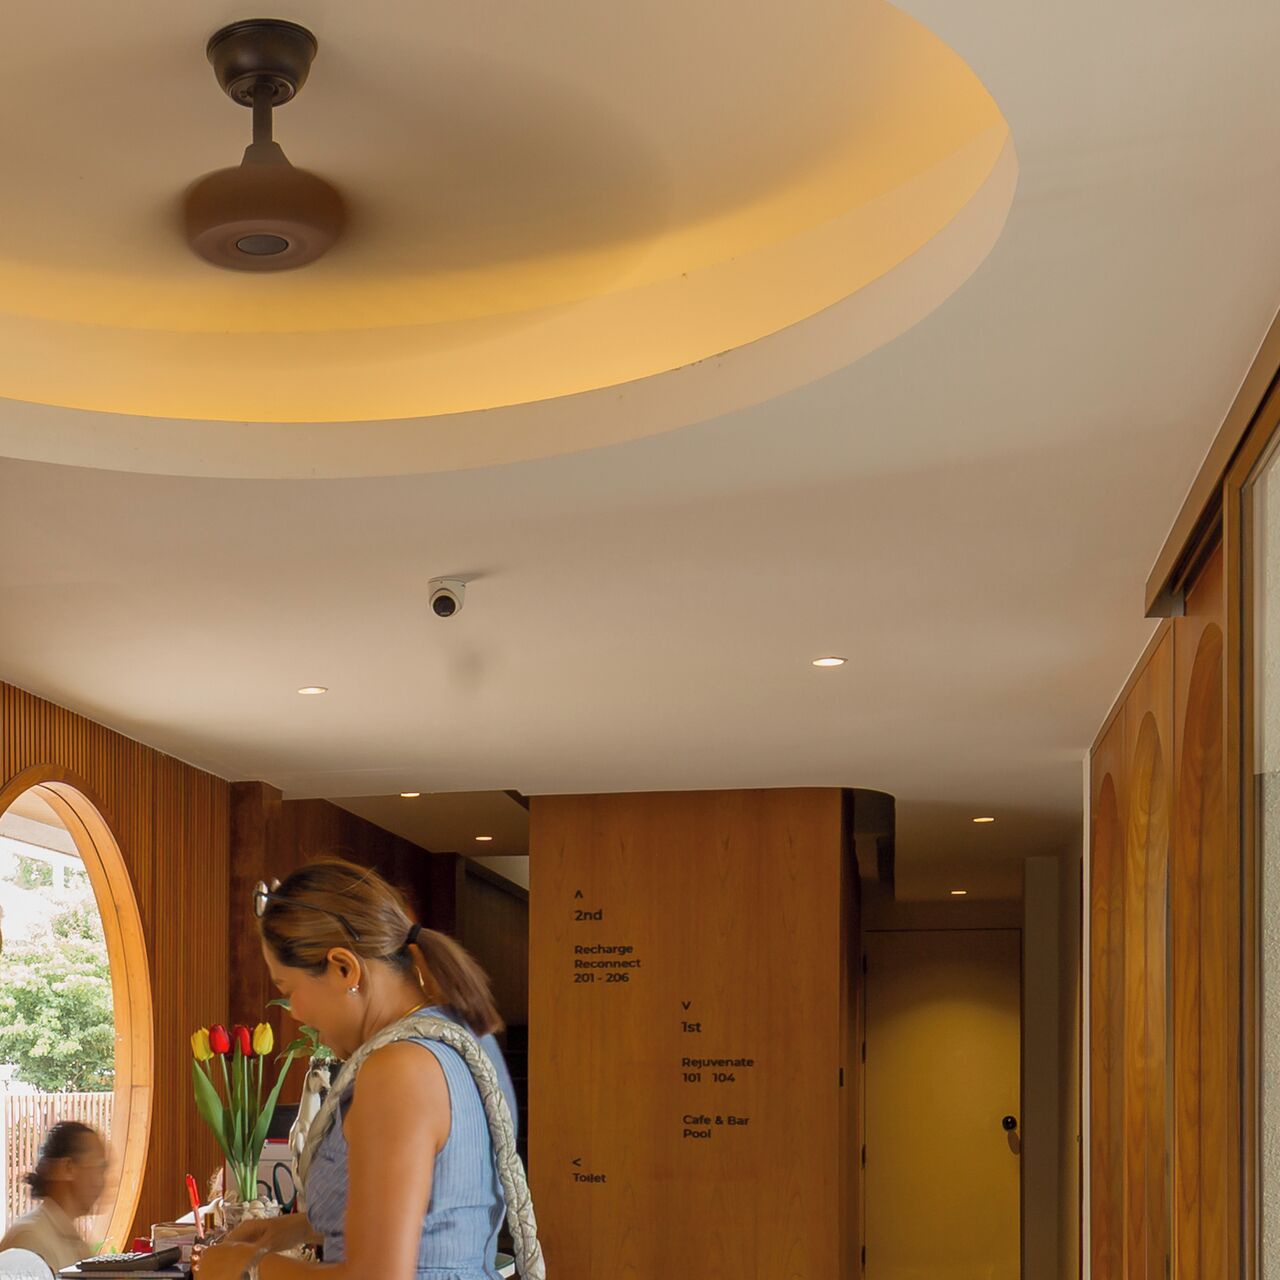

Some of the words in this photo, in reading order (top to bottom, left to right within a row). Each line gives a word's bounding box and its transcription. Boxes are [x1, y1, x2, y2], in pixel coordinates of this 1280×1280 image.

[574, 908, 603, 921] 2nd
[574, 943, 634, 956] Recharge
[574, 959, 641, 969] Reconnect
[574, 973, 595, 983] 201
[606, 973, 630, 983] 206
[681, 1021, 702, 1033] 1st
[681, 1057, 755, 1069] Rejuvenate
[683, 1072, 702, 1083] 101
[712, 1072, 736, 1083] 104
[682, 1114, 711, 1125] Cafe
[714, 1115, 724, 1126] &
[727, 1115, 750, 1126] Bar
[683, 1128, 712, 1139] Pool
[572, 1172, 607, 1184] Toilet
